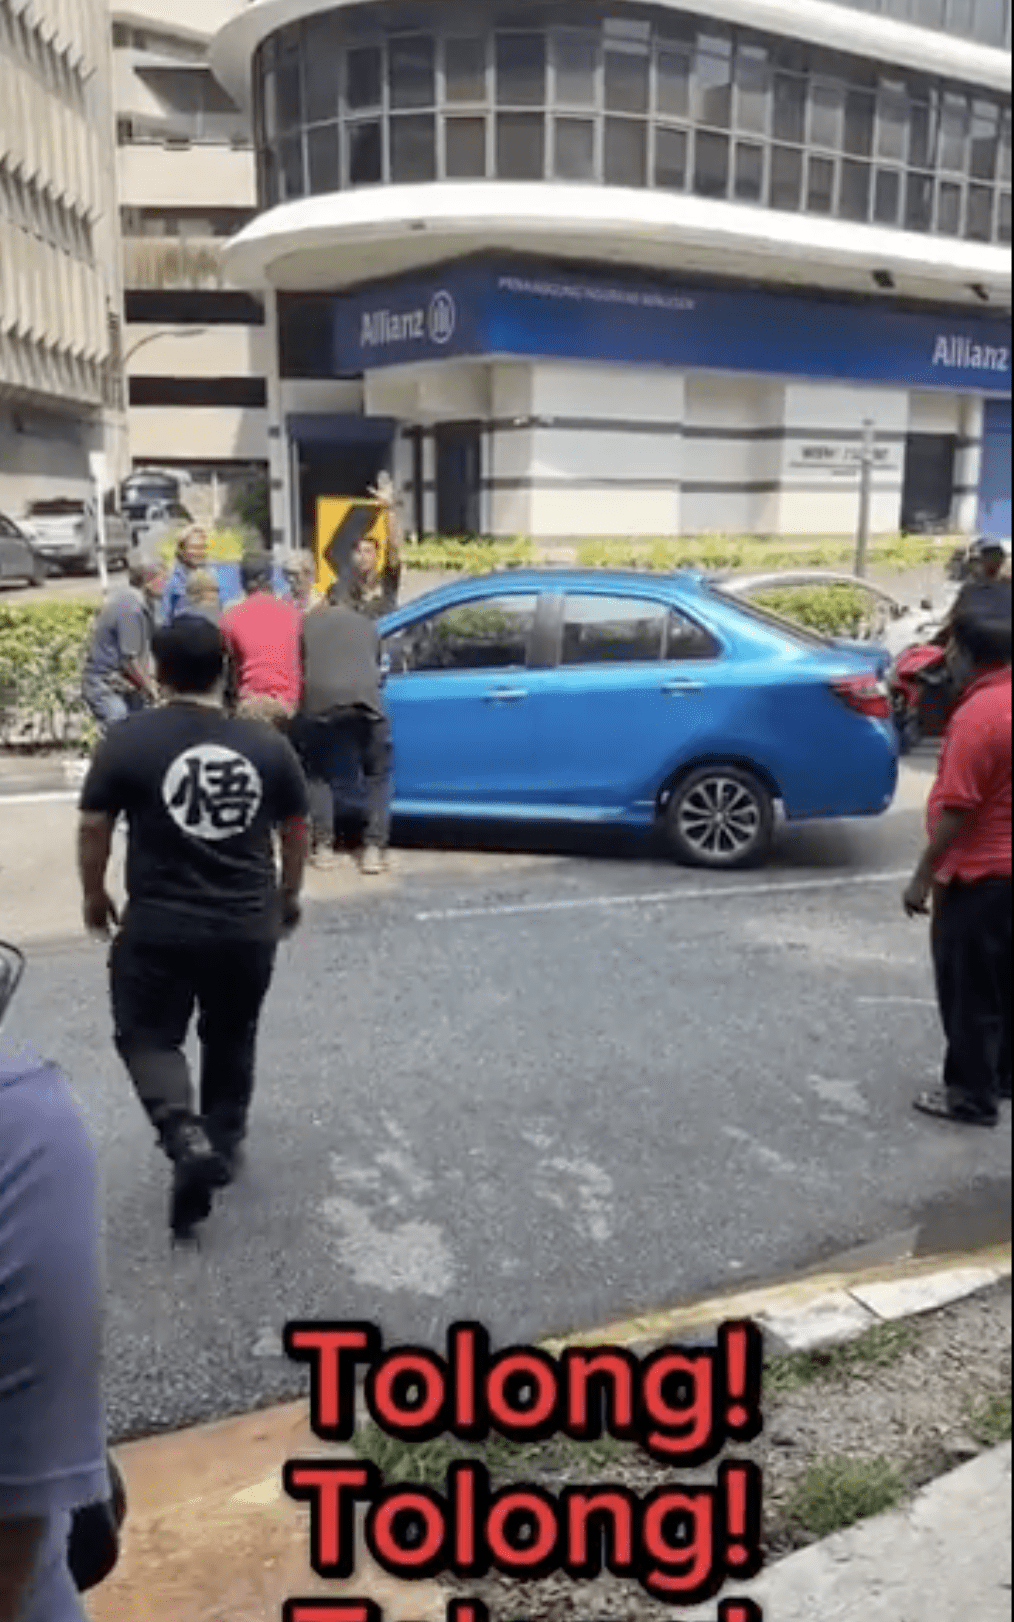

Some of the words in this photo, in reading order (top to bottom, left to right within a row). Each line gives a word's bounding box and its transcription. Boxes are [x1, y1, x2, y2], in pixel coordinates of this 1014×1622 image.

[360, 308, 424, 347] Allianz
[931, 334, 1009, 372] Allianz
[171, 757, 258, 829] 悟
